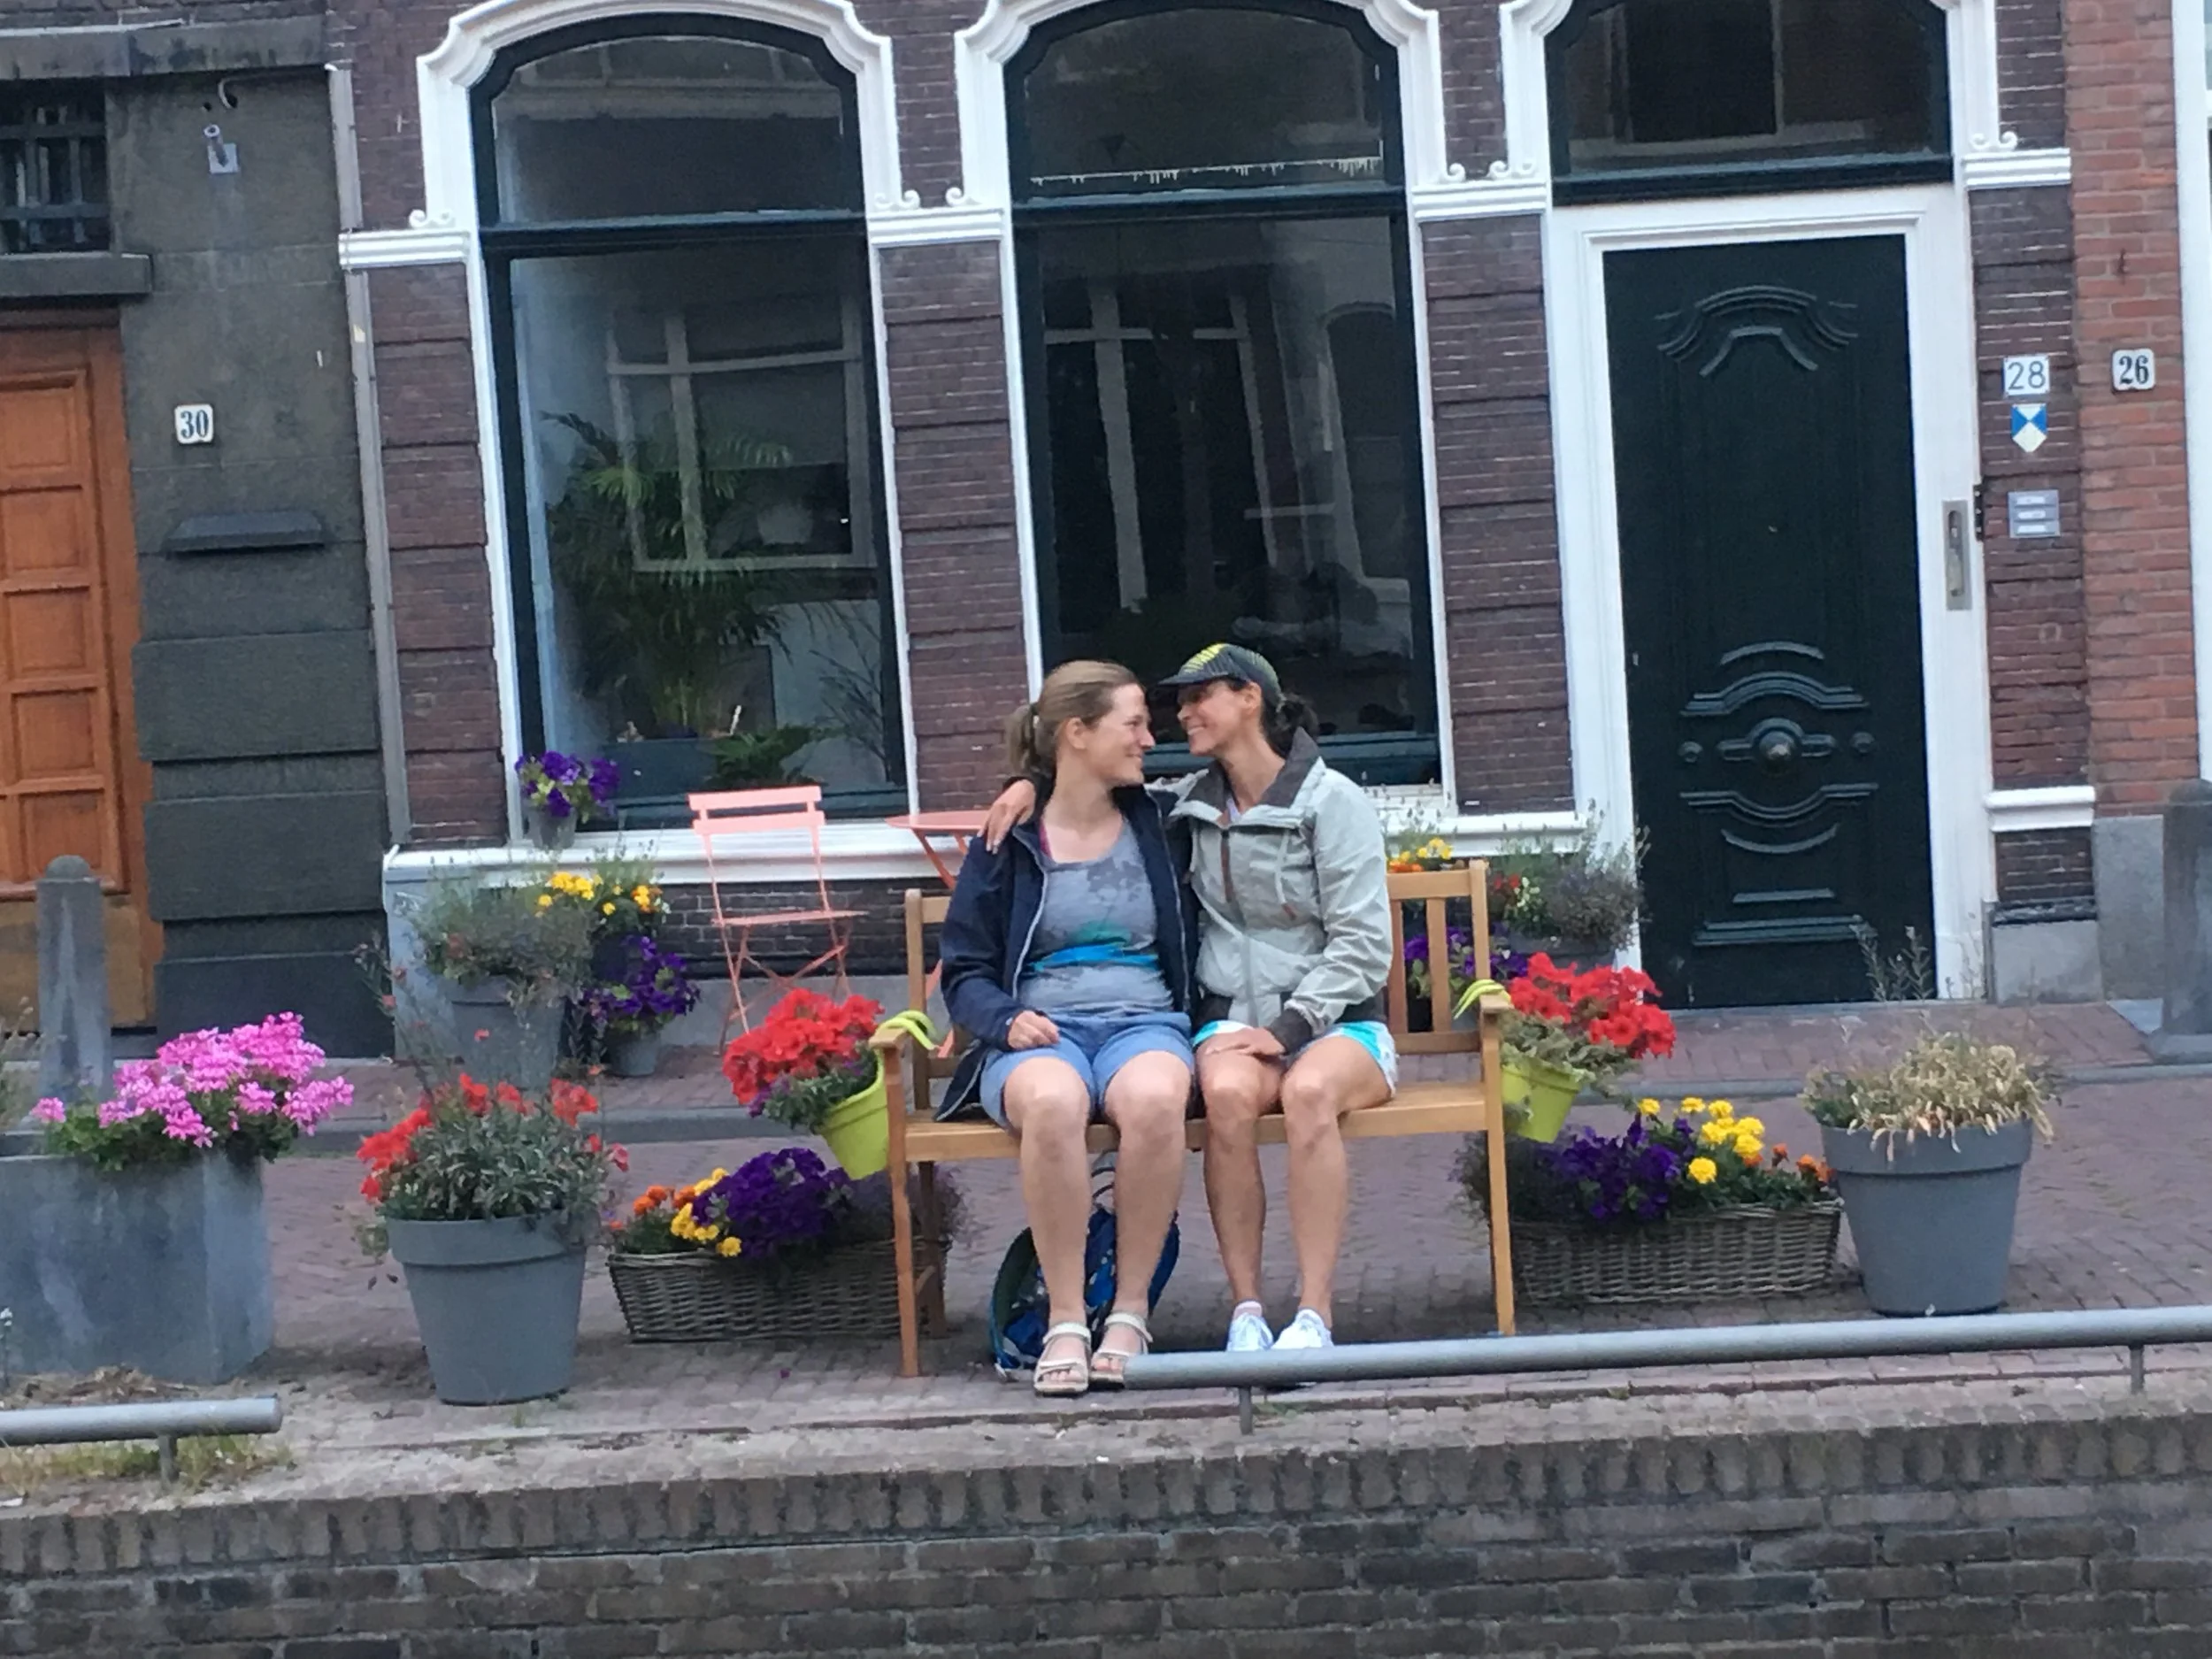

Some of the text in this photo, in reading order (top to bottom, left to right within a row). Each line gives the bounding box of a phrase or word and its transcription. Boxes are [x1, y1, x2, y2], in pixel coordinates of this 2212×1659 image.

[2008, 361, 2046, 390] 28
[2118, 355, 2149, 385] 26
[180, 410, 209, 439] 30
